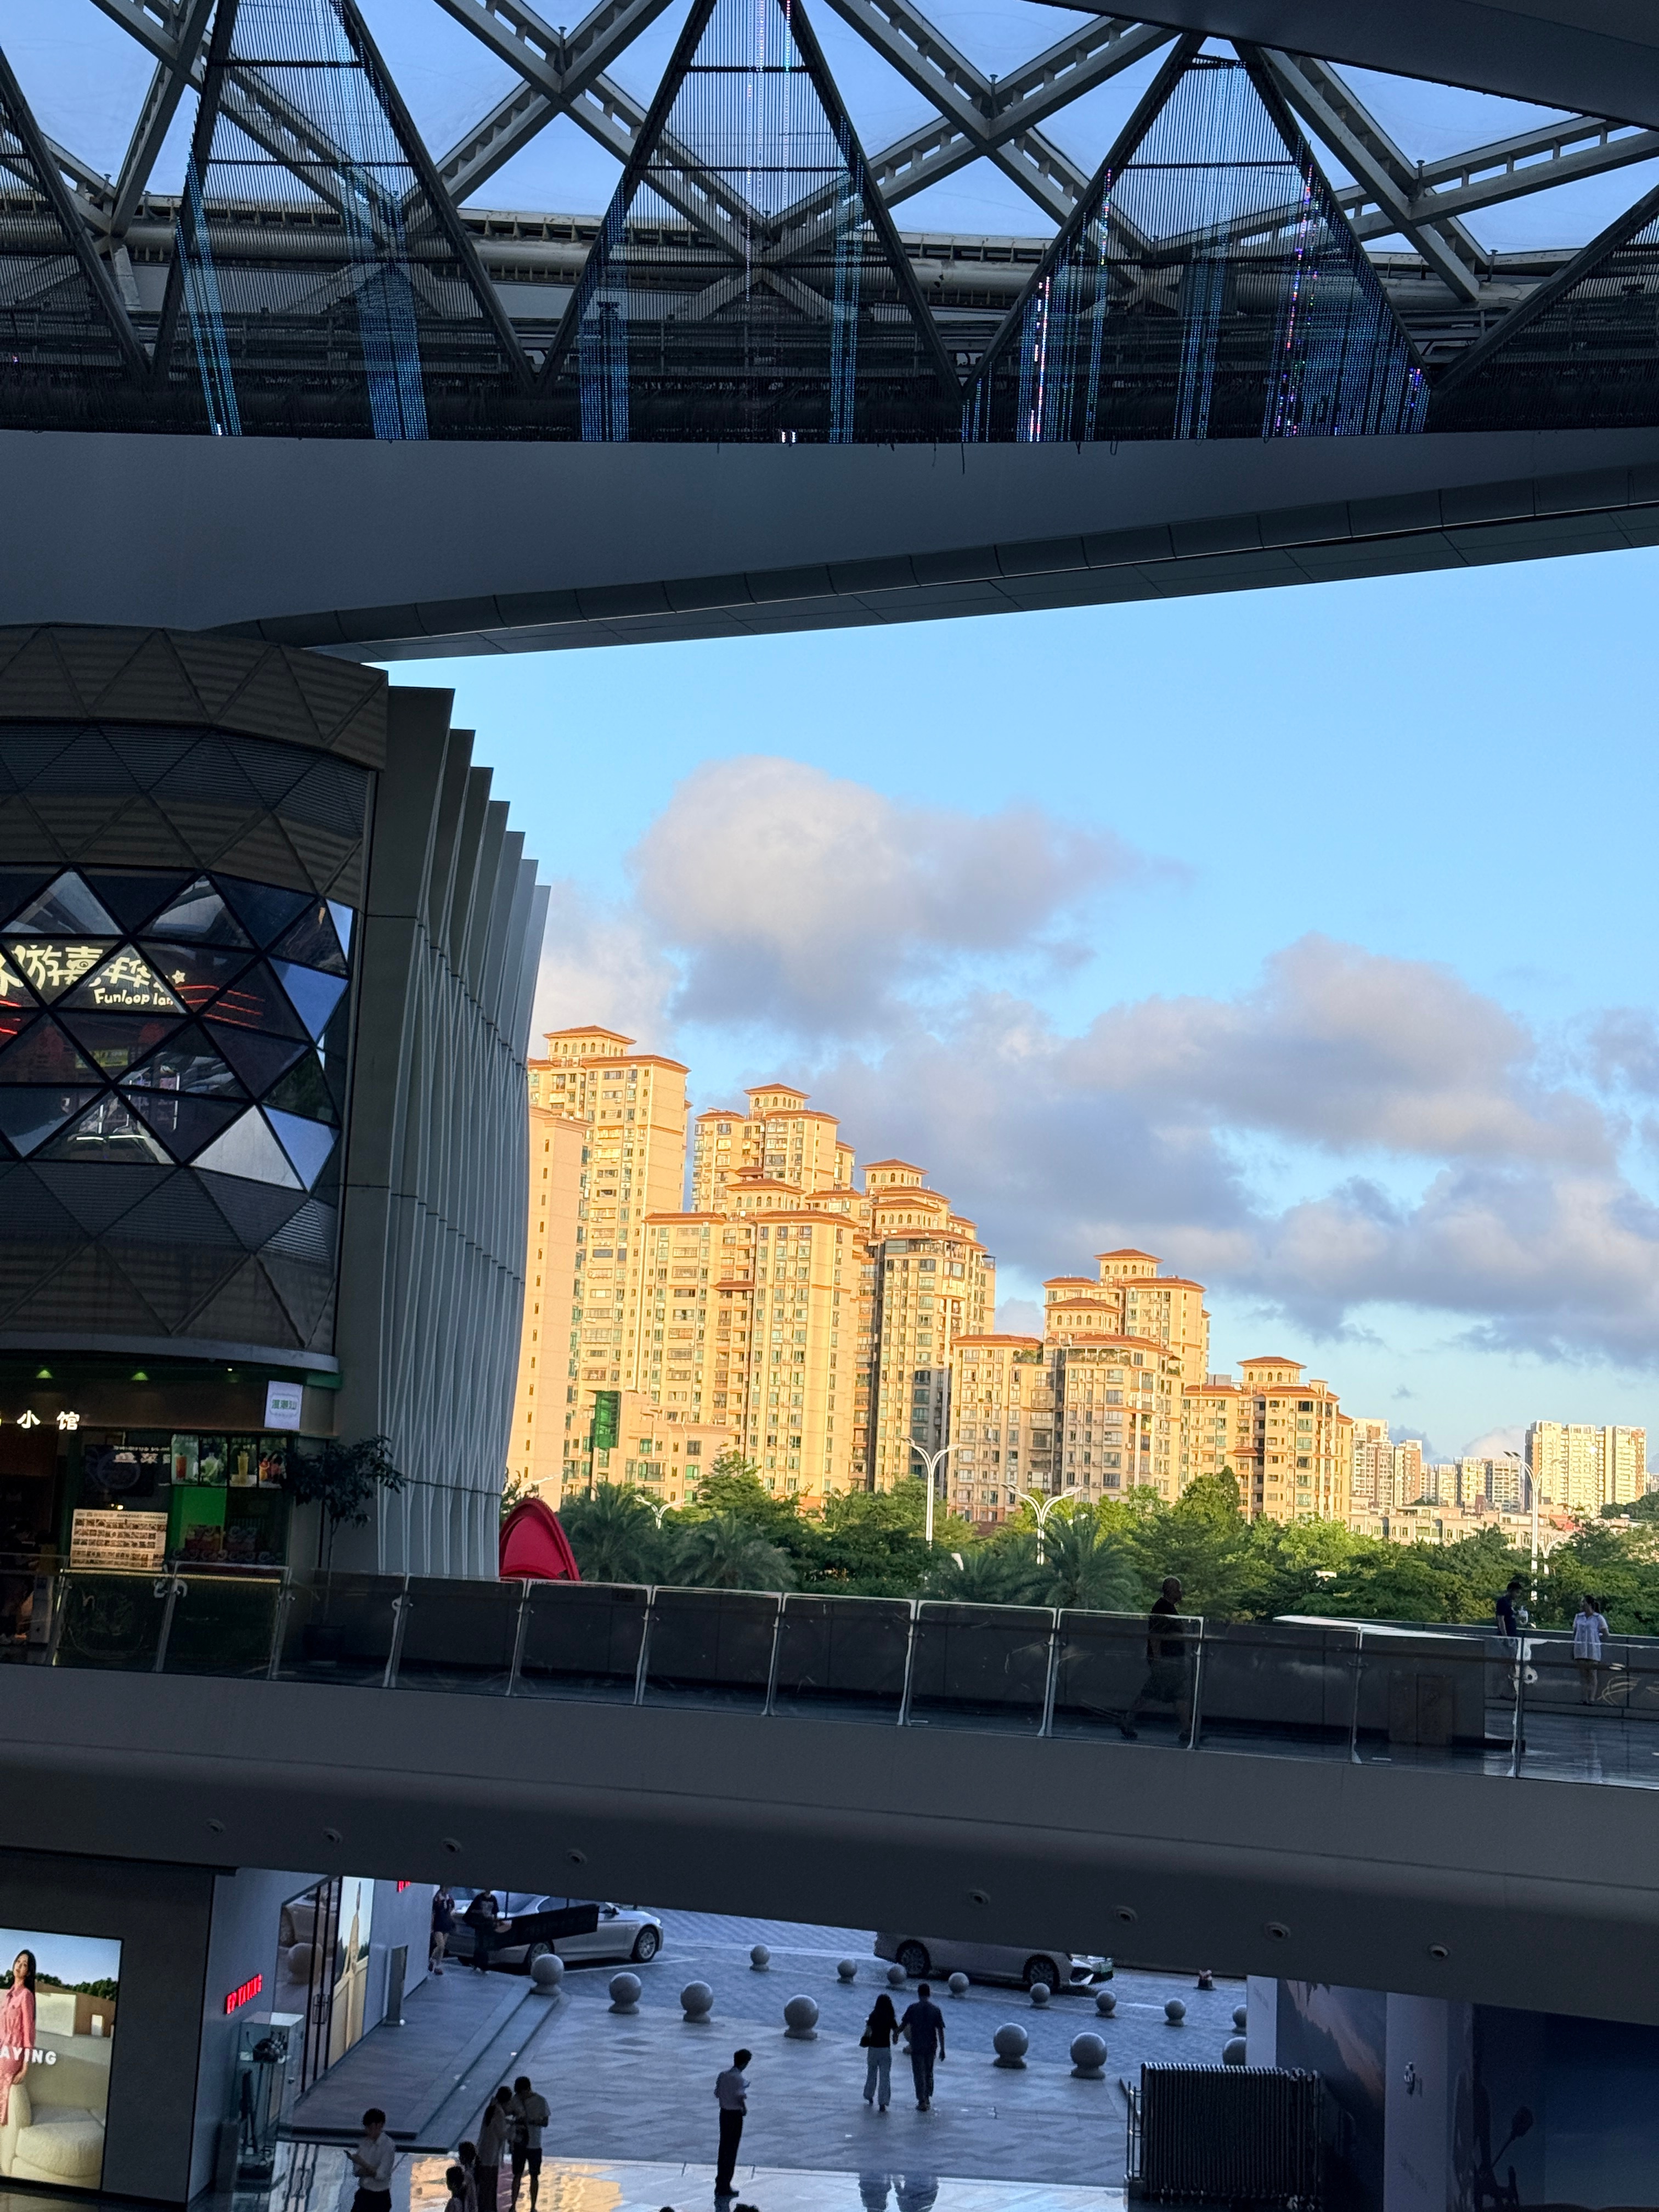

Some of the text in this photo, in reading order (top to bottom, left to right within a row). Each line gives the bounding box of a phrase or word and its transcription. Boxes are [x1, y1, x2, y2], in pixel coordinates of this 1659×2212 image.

[94, 988, 184, 1006] Funloop lan
[0, 1409, 80, 1430] 小馆
[0, 2045, 57, 2066] AYING
